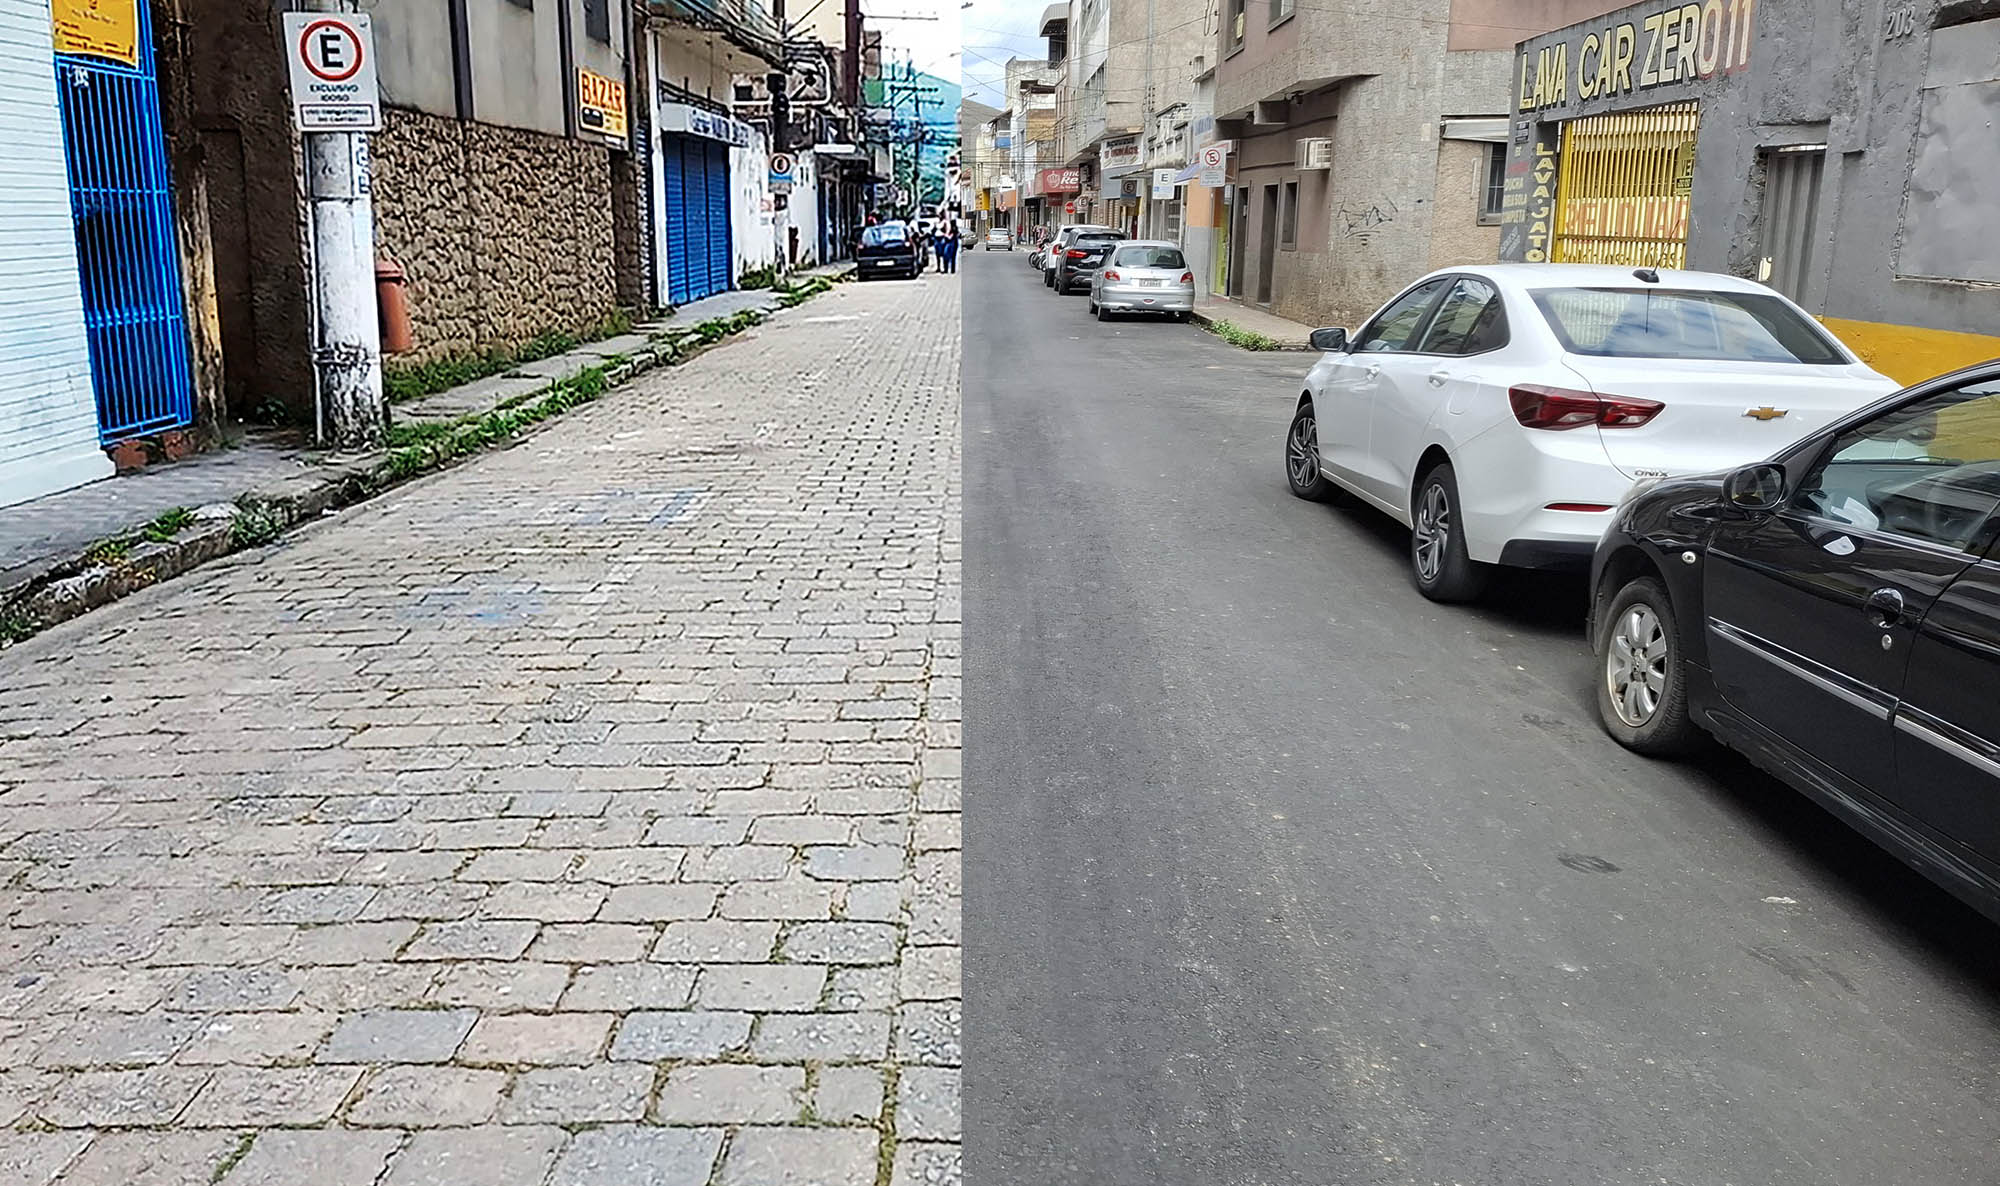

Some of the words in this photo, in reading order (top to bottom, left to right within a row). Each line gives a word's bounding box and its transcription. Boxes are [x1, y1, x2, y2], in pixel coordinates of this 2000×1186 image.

[1885, 6, 1915, 41] 203
[320, 34, 344, 68] E
[1519, 43, 1566, 113] LAVA
[1577, 22, 1634, 101] CAR
[309, 84, 359, 93] EXCLUSIVO
[321, 94, 350, 102] IDOSO
[581, 73, 623, 113] BAZAR
[1161, 173, 1169, 182] E
[1634, 469, 1669, 478] ONIX
